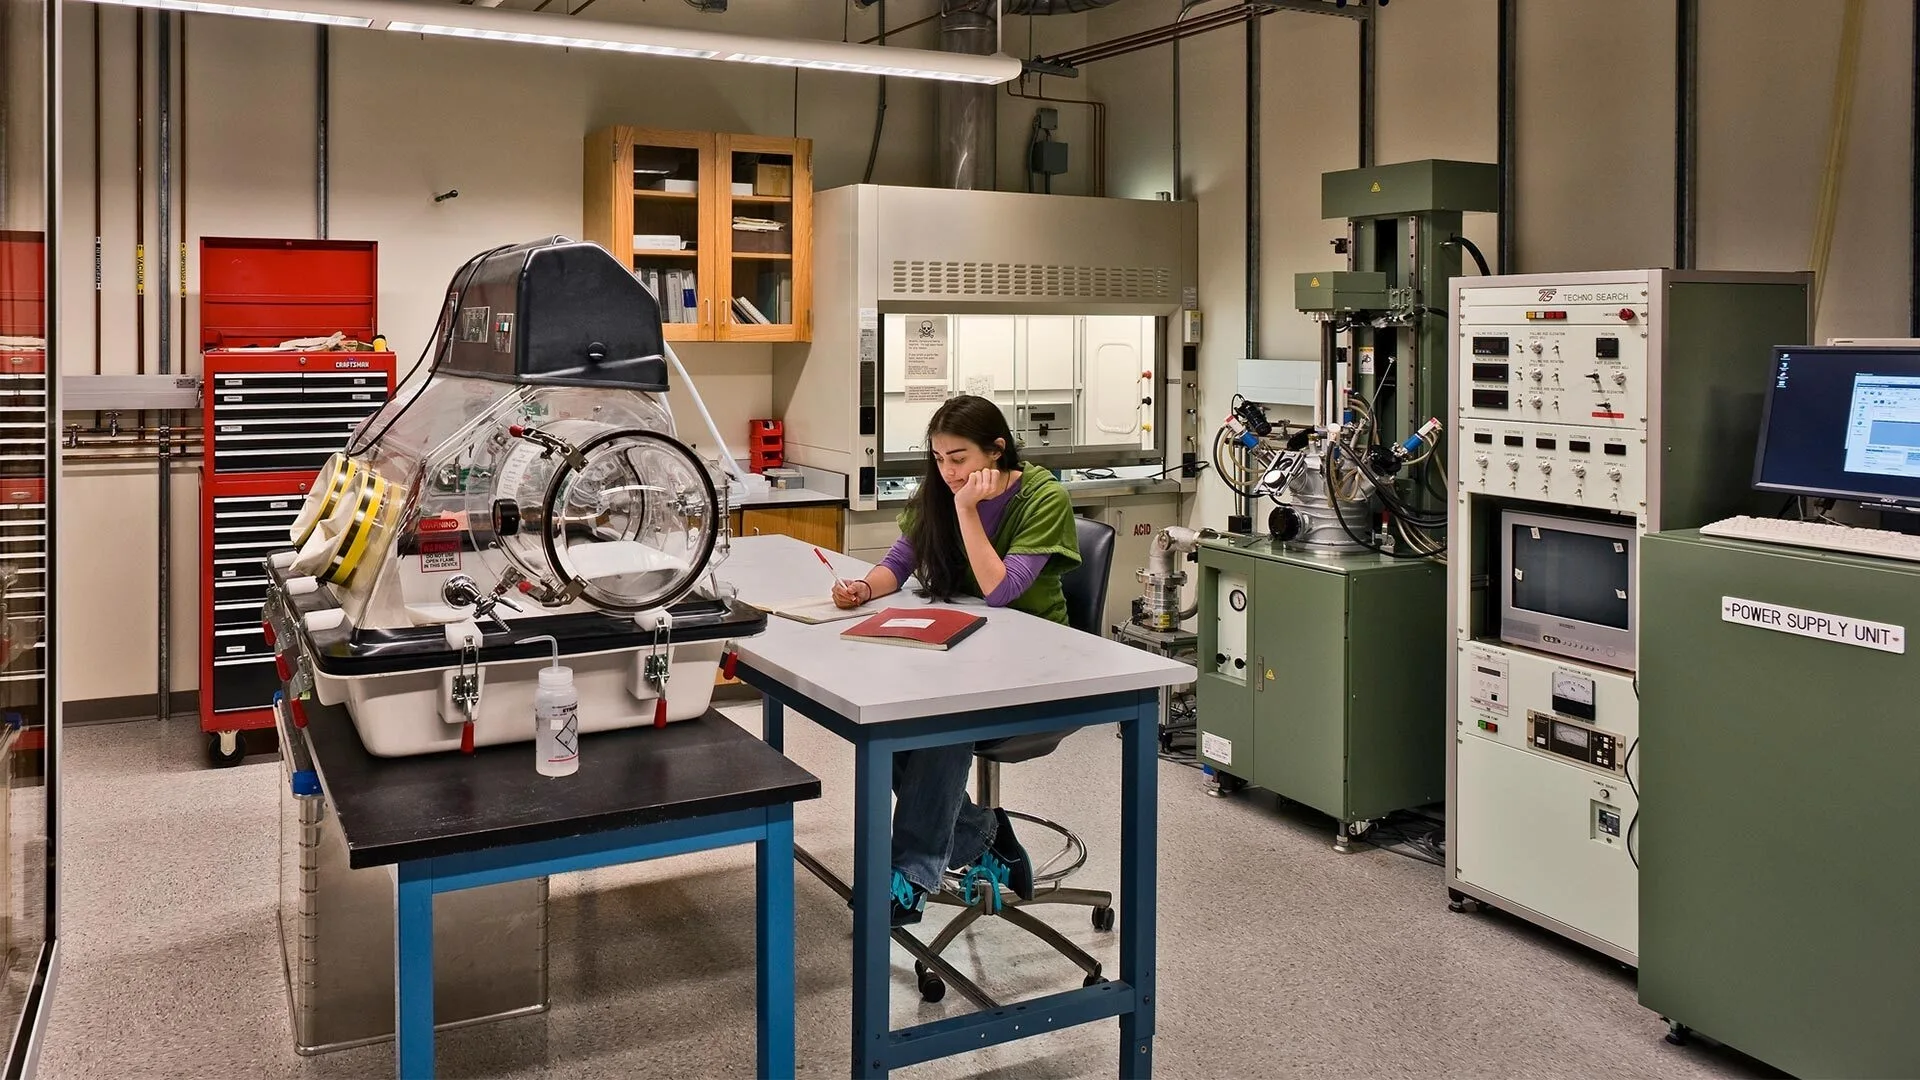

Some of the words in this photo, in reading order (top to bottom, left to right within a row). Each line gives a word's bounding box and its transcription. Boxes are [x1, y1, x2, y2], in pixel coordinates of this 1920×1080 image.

[1563, 293, 1593, 302] TECHNO
[1596, 292, 1629, 301] SEARCH
[335, 361, 369, 369] CRAFTSMAN
[421, 521, 457, 529] WARNING
[1134, 523, 1151, 536] ACID
[1731, 602, 1781, 626] POWER
[1787, 613, 1848, 638] SUPPLY
[1854, 625, 1891, 645] UNIT
